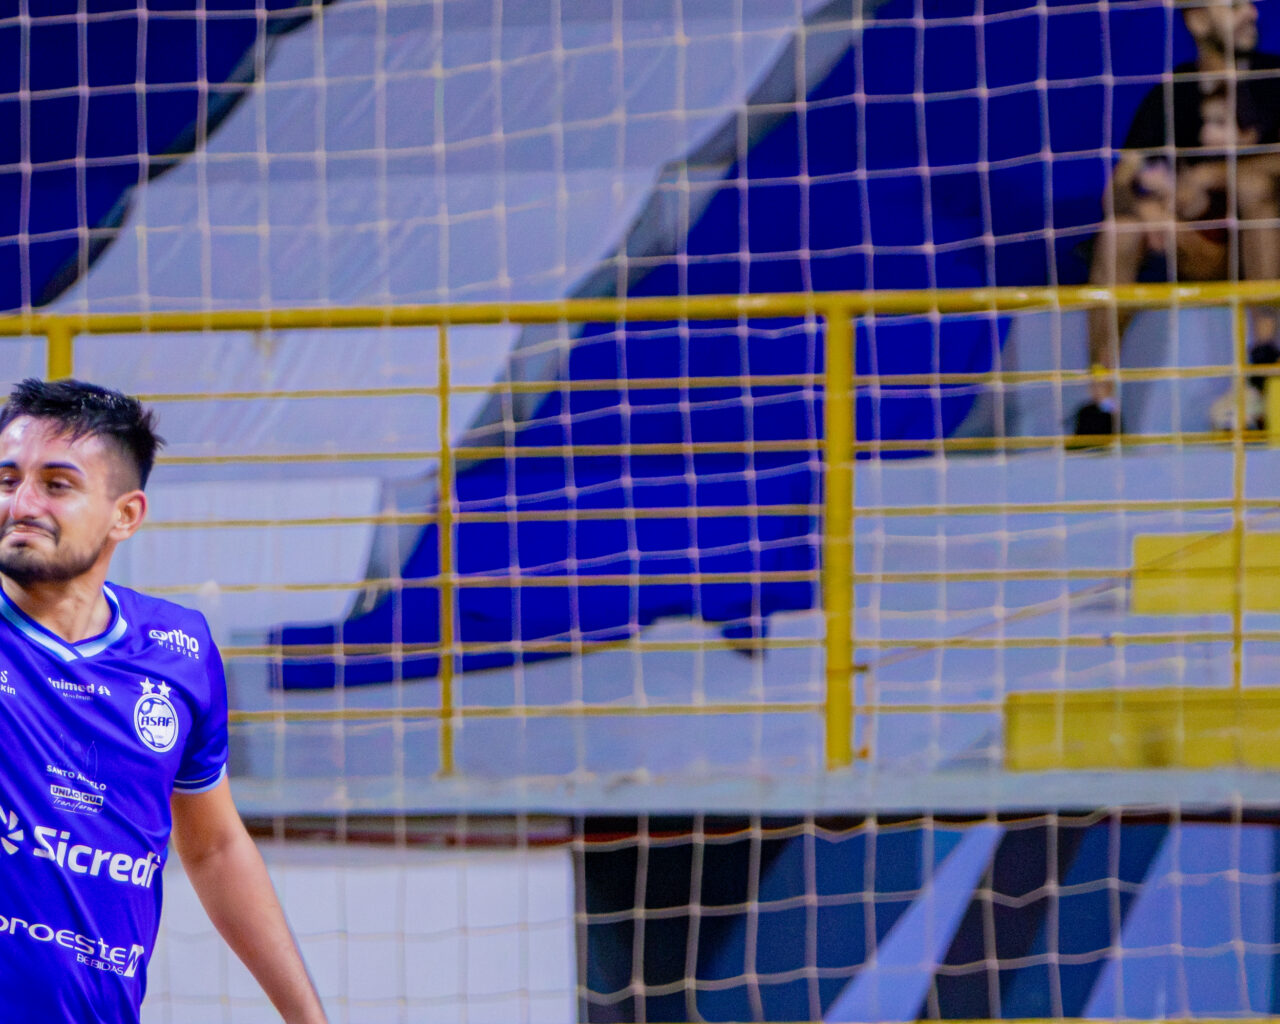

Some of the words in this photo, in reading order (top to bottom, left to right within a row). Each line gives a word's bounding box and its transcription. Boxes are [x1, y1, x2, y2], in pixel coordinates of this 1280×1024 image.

[148, 629, 199, 653] Ortho
[47, 677, 95, 694] nimed
[140, 716, 173, 727] ASAF
[46, 764, 75, 779] SANTO
[77, 953, 124, 976] BEBIDAS
